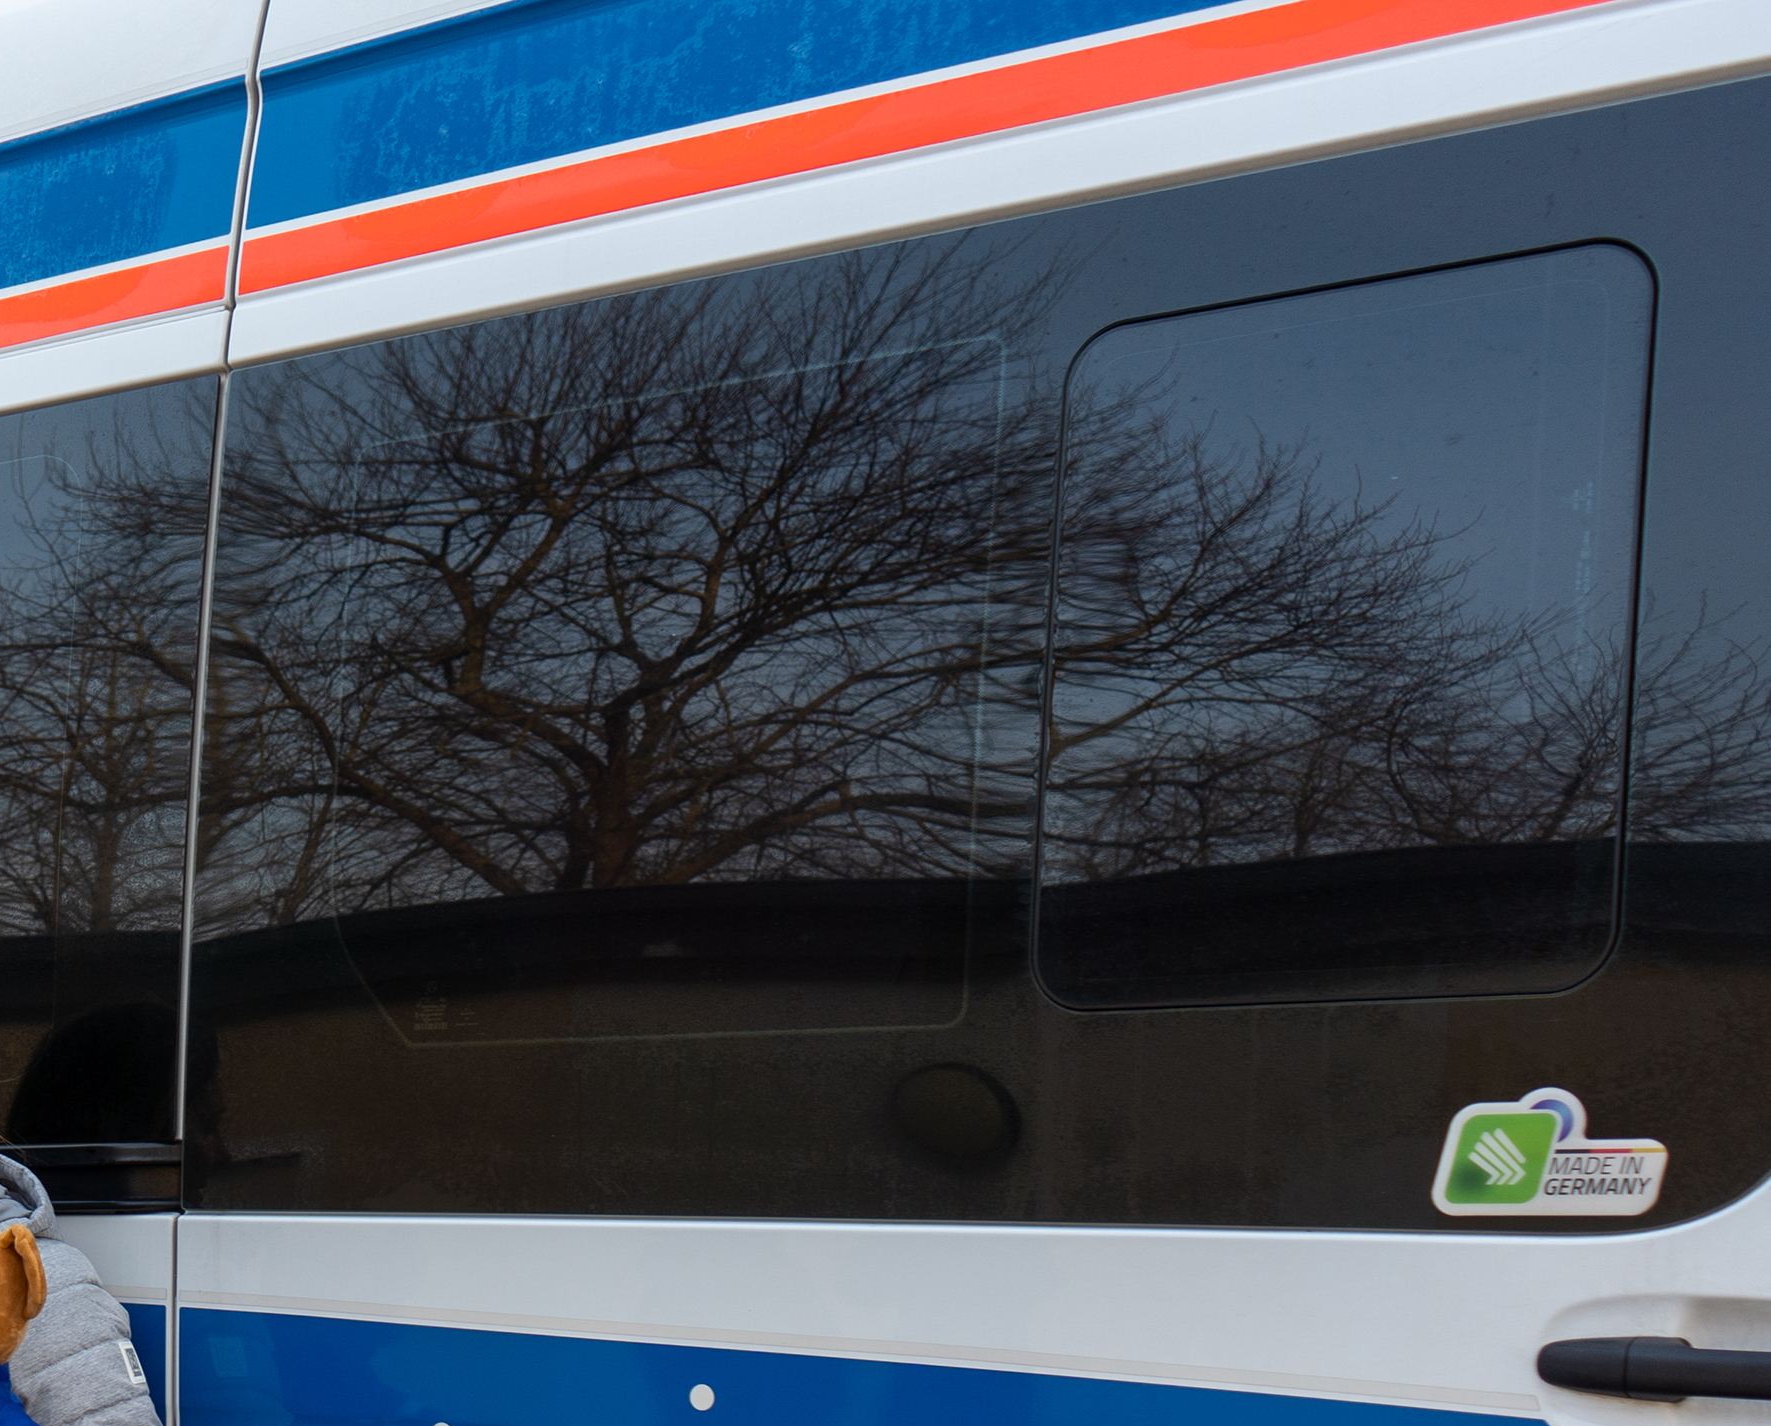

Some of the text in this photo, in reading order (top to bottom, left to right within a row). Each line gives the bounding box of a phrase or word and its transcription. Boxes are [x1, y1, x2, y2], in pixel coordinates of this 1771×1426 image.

[1548, 1156, 1645, 1176] MADE IN
[1544, 1177, 1652, 1196] GERMANY
